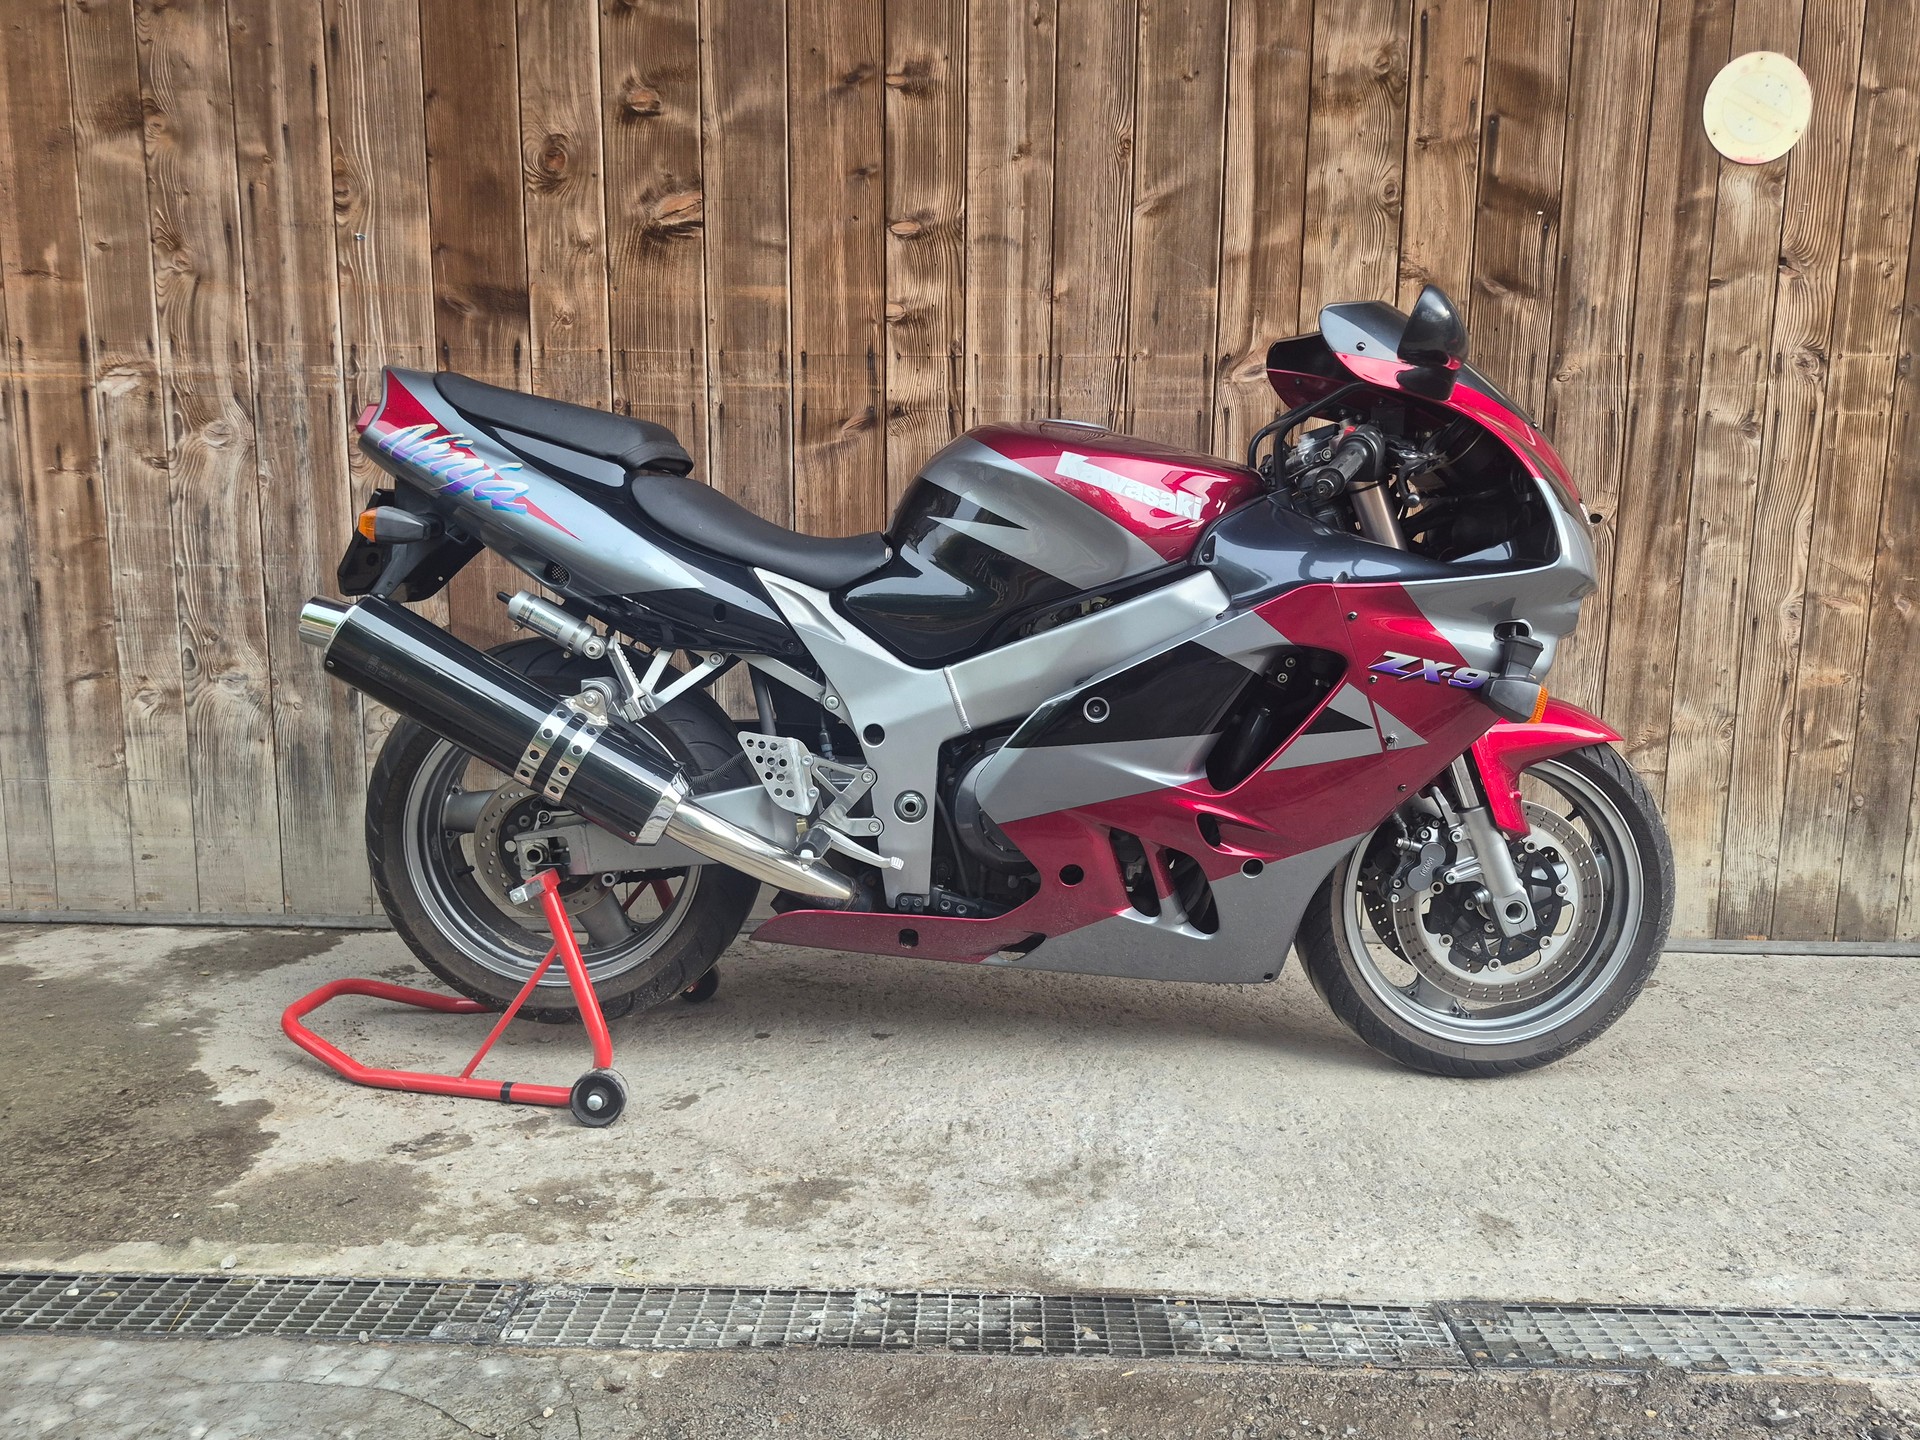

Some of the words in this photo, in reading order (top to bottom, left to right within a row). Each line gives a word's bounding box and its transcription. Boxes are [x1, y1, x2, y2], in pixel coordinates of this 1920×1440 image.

[378, 423, 529, 515] Ninja
[1055, 451, 1202, 521] Kawasaki
[1367, 650, 1500, 690] ZX-9
